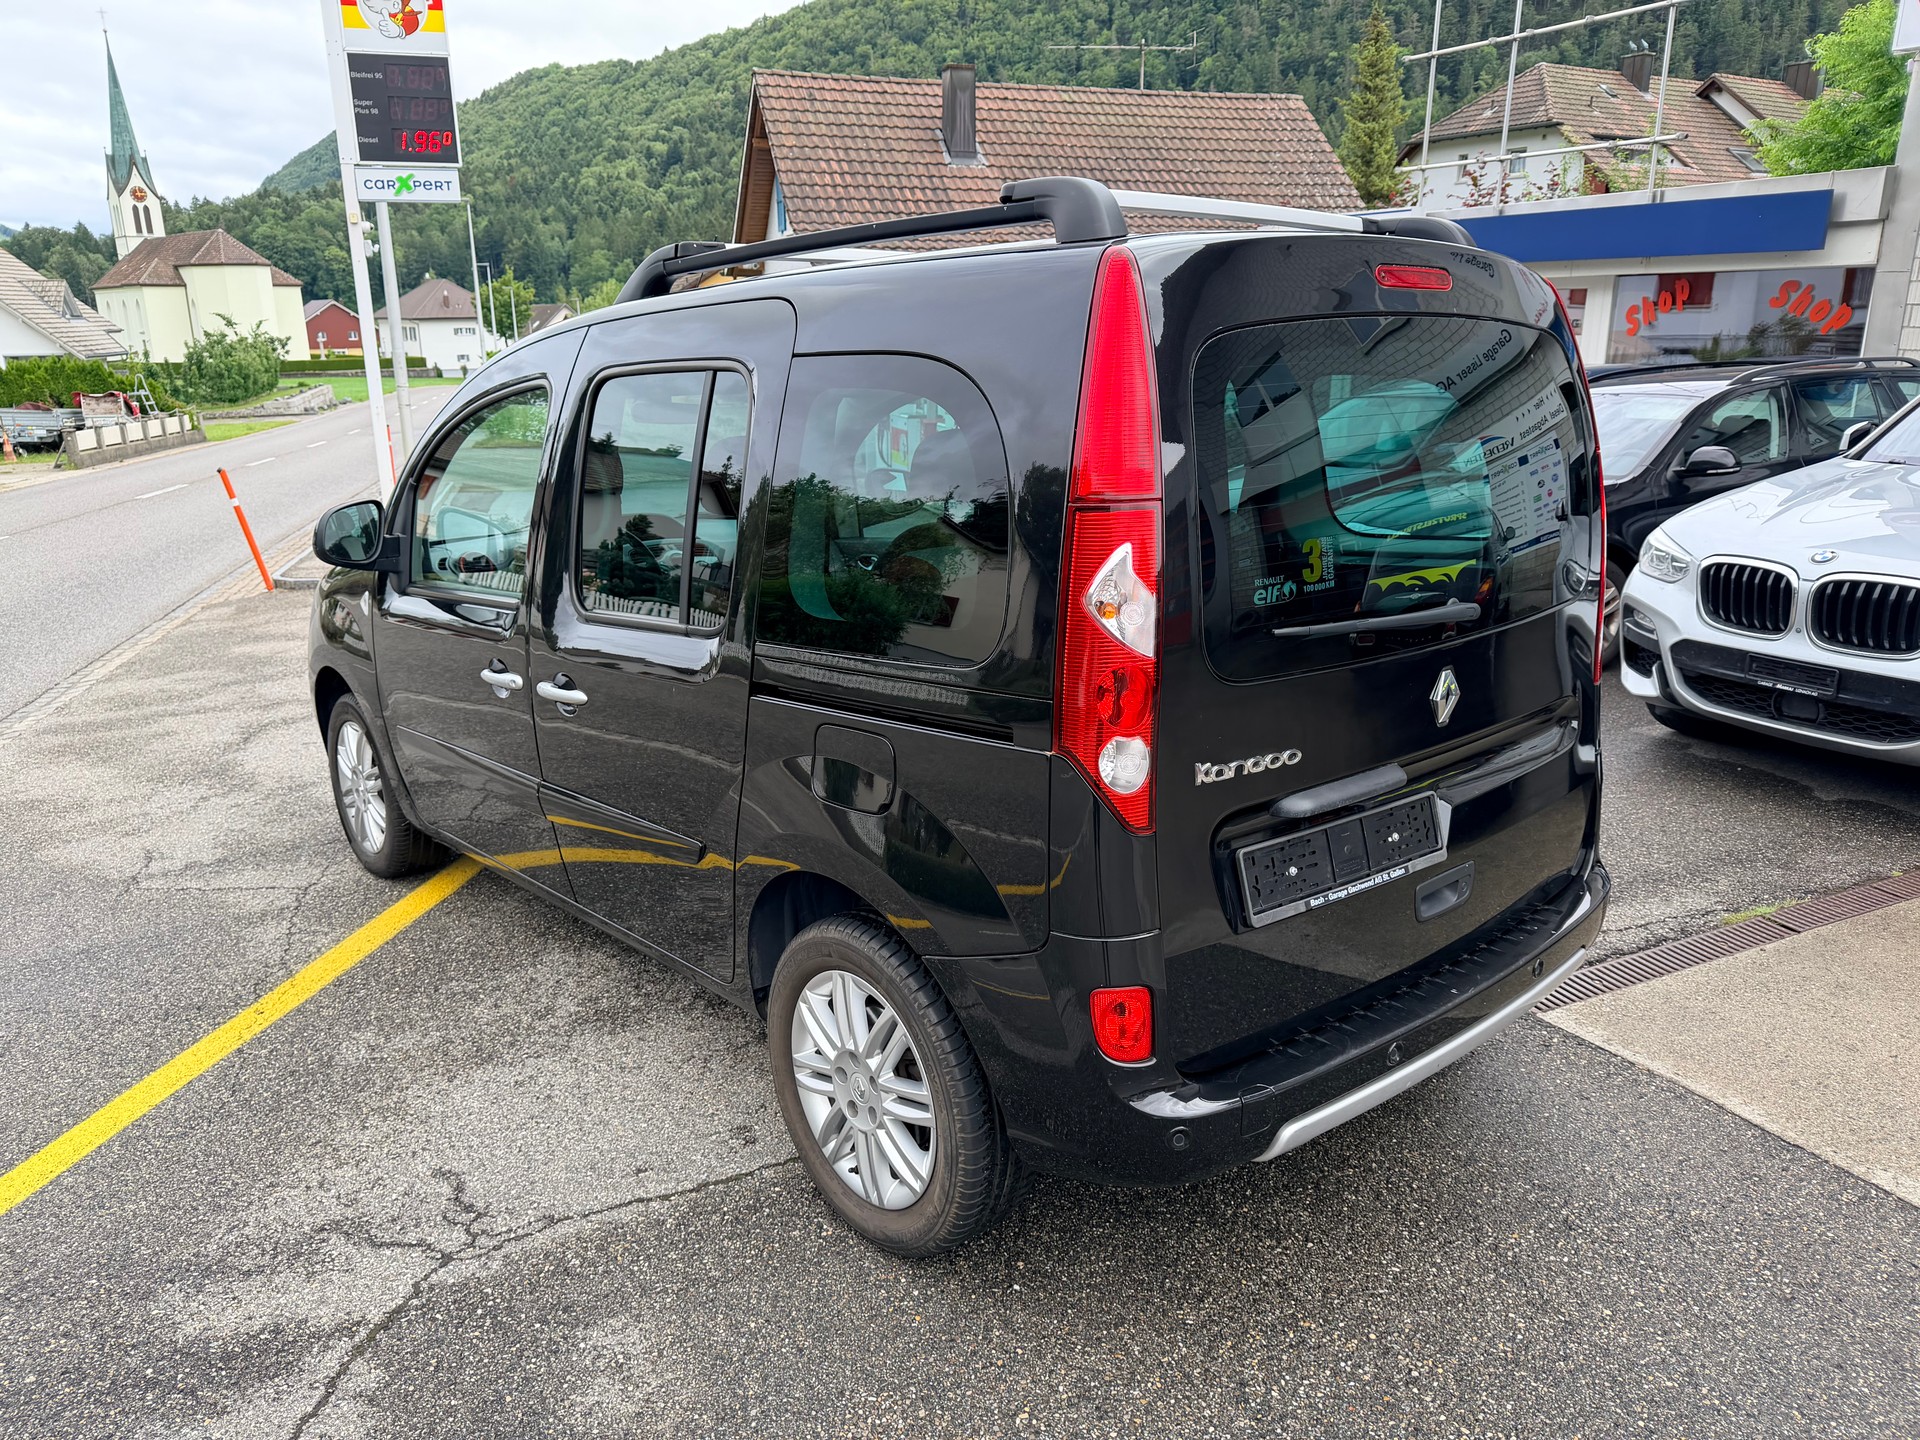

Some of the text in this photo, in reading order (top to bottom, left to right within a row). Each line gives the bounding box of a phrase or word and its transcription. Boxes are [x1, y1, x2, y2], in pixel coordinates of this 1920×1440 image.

[1625, 277, 1690, 337] Shop
[1768, 279, 1854, 336] Shop
[1302, 538, 1322, 583] 3
[1326, 535, 1335, 579] GARANTIE
[1253, 585, 1281, 605] elf
[1254, 575, 1285, 587] RENAULT
[1194, 748, 1303, 786] Kangoo
[1310, 896, 1325, 906] Bach
[1328, 889, 1348, 901] Garage
[1347, 879, 1375, 894] Gschwend
[1374, 875, 1383, 885] AG
[1383, 873, 1391, 881] St.
[1390, 868, 1406, 878] Gallen
